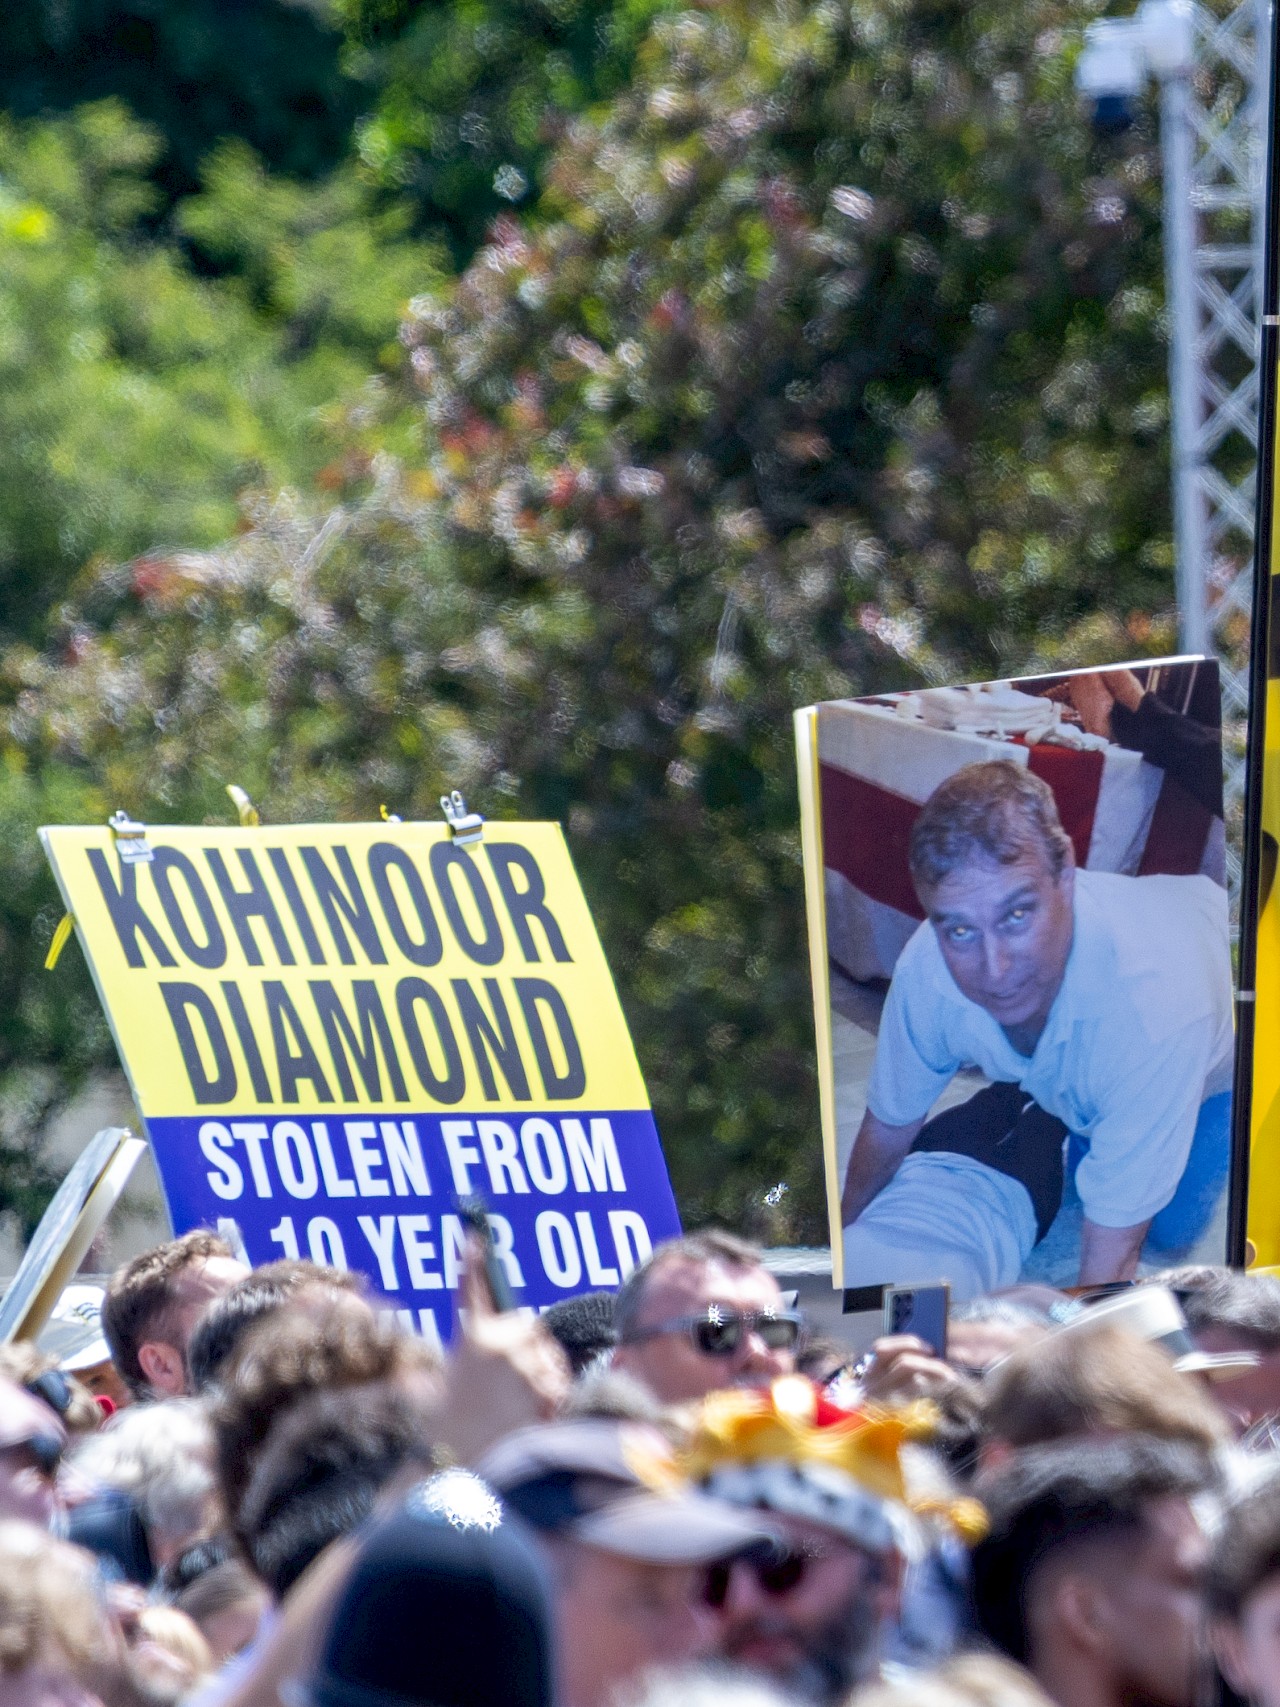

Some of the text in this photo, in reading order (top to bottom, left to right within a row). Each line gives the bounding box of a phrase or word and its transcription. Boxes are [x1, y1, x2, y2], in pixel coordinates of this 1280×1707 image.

[83, 841, 575, 969] KOHINOOR
[158, 976, 587, 1105] DIAMOND
[198, 1117, 627, 1200] STOLEN FROM
[535, 1209, 653, 1289] OLD
